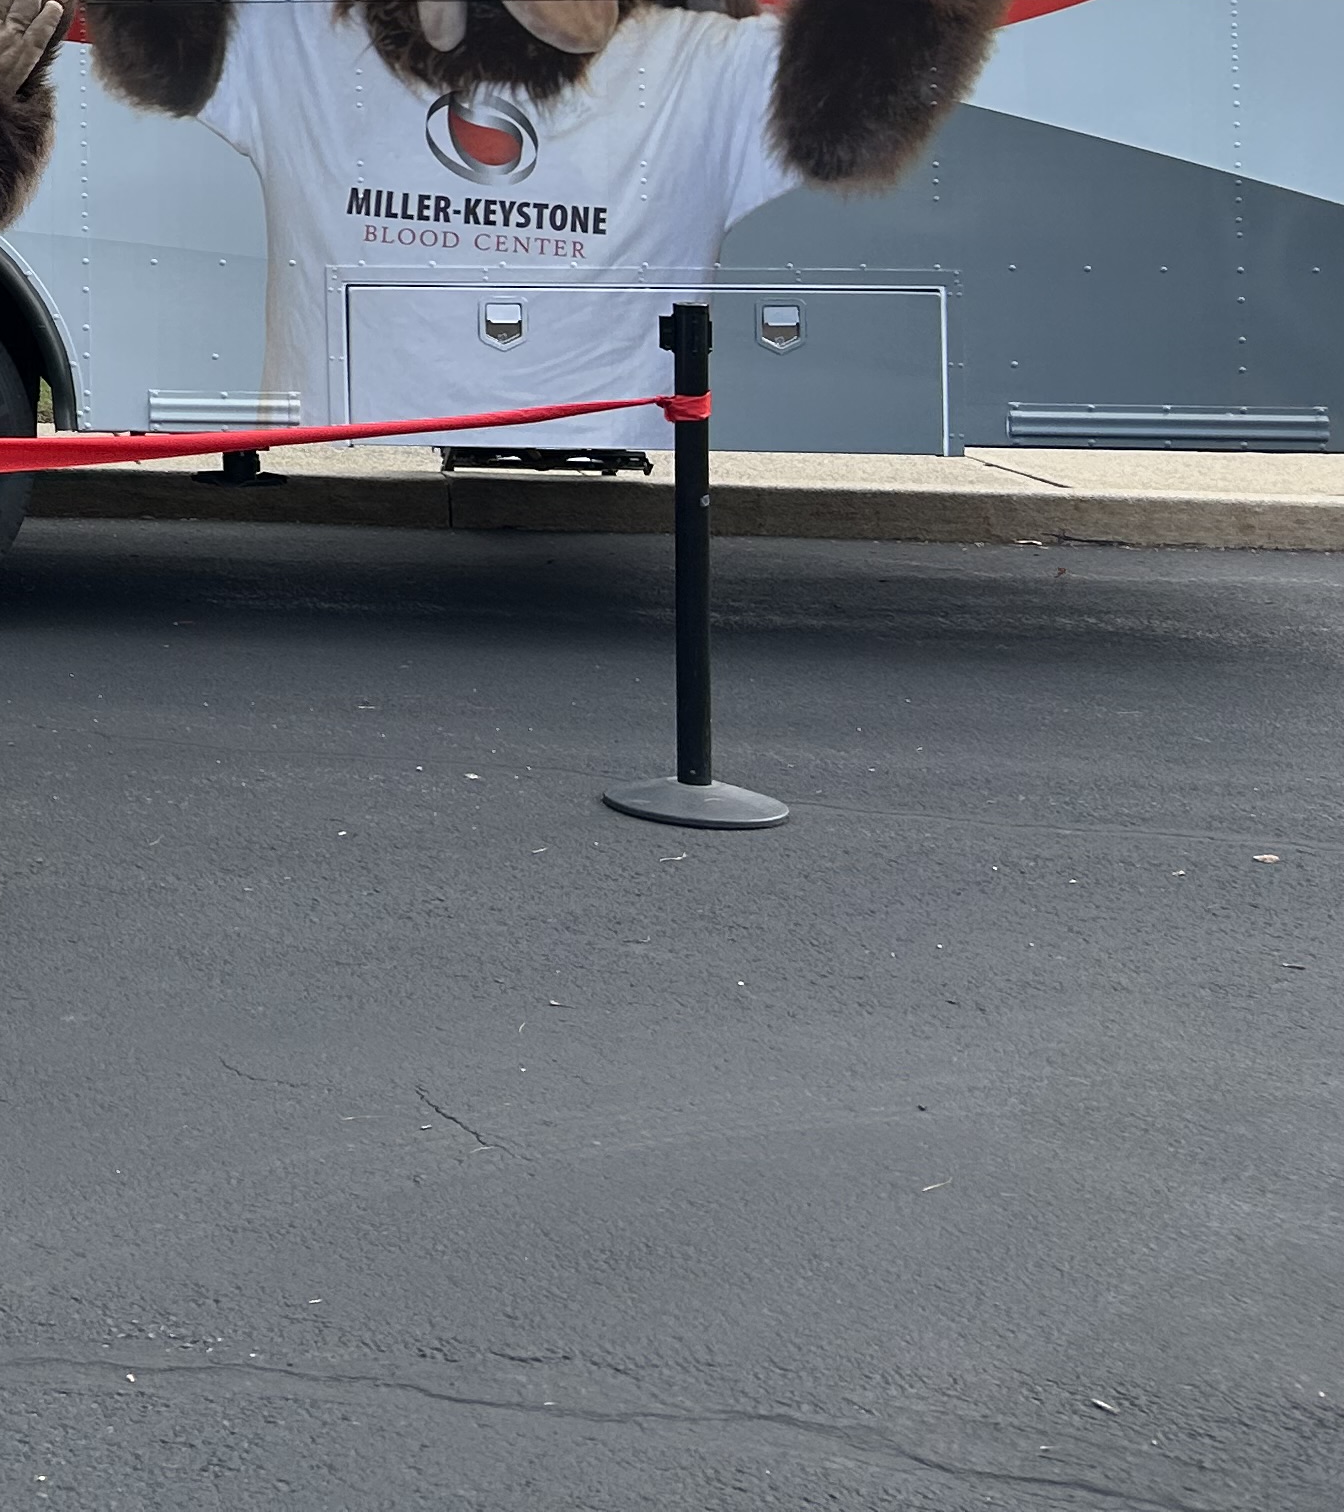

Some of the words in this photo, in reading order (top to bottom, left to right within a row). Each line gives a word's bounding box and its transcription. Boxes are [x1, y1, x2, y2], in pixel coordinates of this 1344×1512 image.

[346, 187, 608, 236] MILLER-KEYSTONE
[363, 224, 460, 249] BLOOD
[473, 233, 587, 259] CENTER
